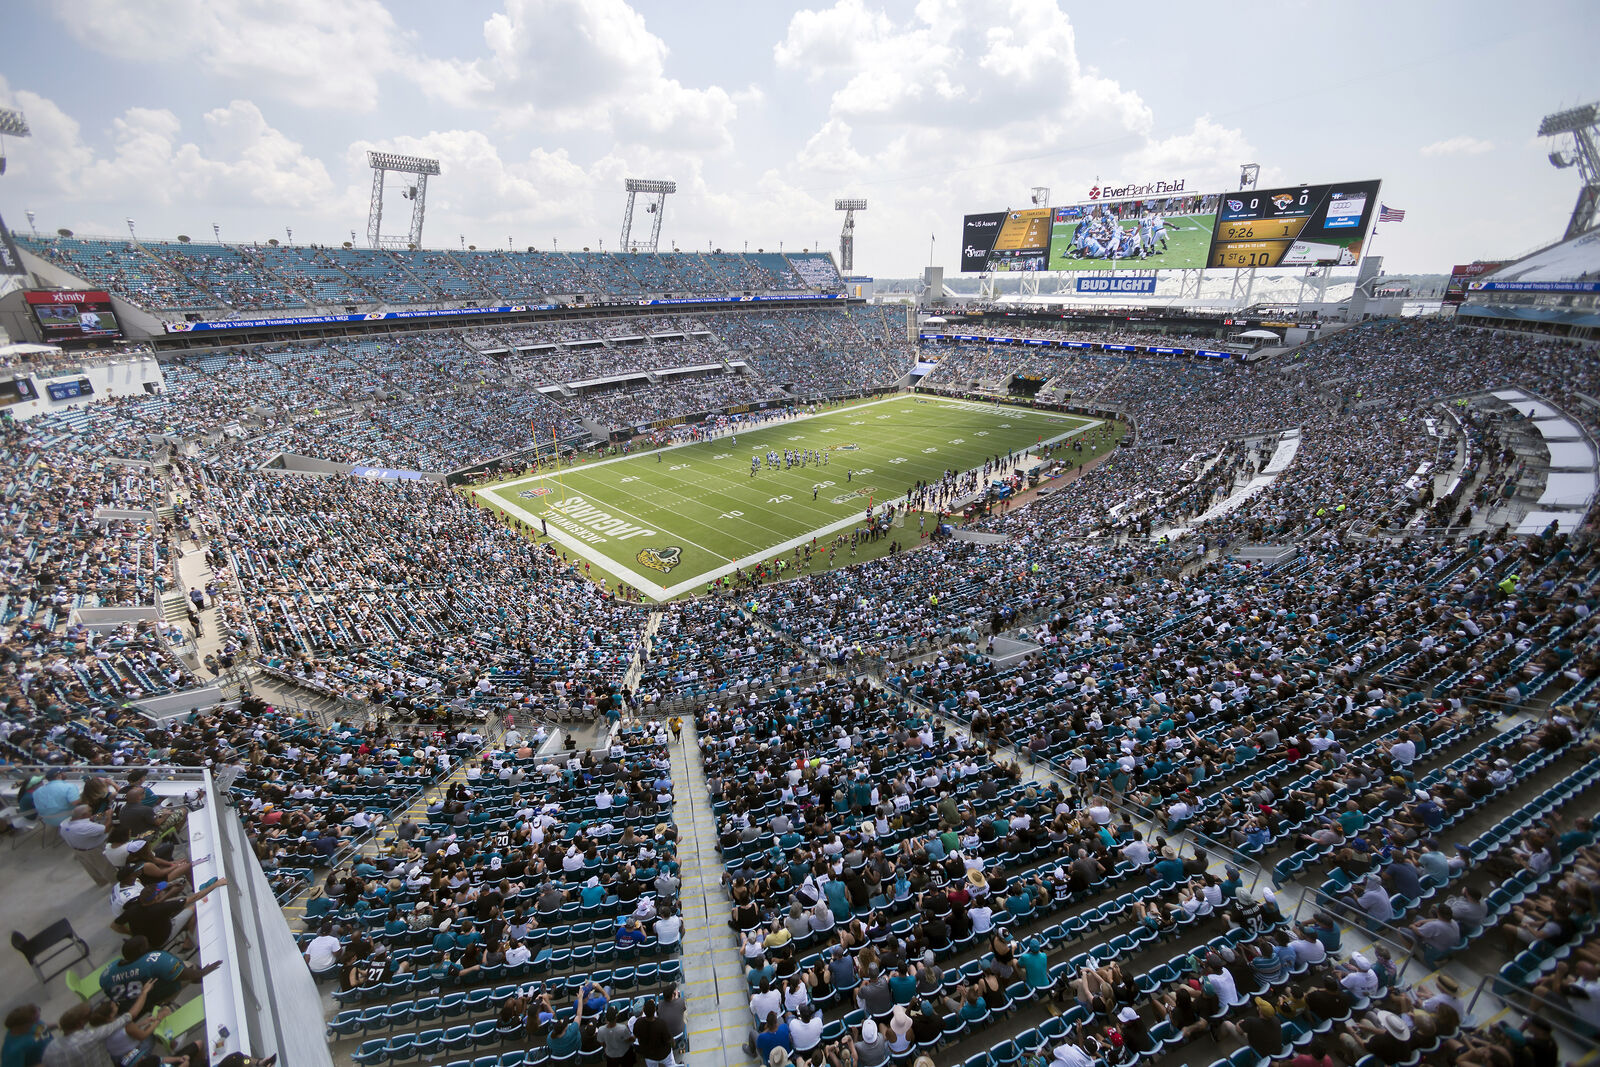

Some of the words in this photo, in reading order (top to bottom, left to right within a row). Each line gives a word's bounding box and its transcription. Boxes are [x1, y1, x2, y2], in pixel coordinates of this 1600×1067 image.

[1103, 183, 1154, 197] EverBank
[1156, 179, 1184, 192] Field
[1250, 199, 1258, 208] 0
[1299, 195, 1308, 205] 0
[1228, 228, 1253, 238] 9:26
[1282, 226, 1289, 236] 1
[1218, 254, 1225, 266] 1
[1248, 253, 1269, 266] 10
[1081, 280, 1109, 290] BUD
[1110, 280, 1152, 290] LIGHT
[53, 292, 86, 302] xfinity
[812, 480, 836, 489] 30
[767, 494, 793, 504] 20
[554, 497, 656, 540] JAGUARS
[718, 510, 744, 519] 10
[645, 808, 653, 816] 15
[497, 836, 508, 846] 20
[1247, 914, 1264, 933] 32
[112, 968, 139, 982] TAYLOR
[368, 968, 384, 981] 27
[110, 981, 143, 1000] 28
